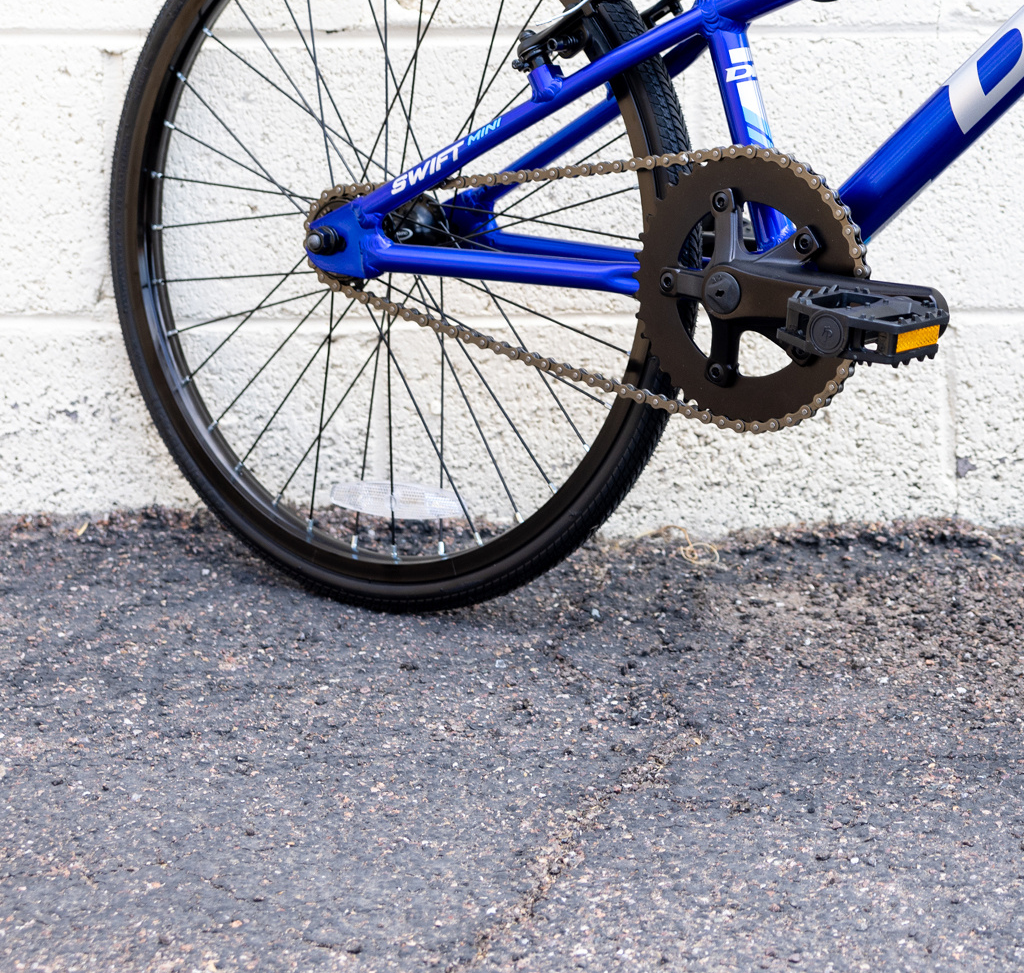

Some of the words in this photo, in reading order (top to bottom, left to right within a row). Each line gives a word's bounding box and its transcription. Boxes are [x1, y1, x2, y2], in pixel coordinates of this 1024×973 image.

[725, 64, 757, 83] D
[391, 140, 465, 195] SWIFT
[467, 117, 501, 146] MINI
